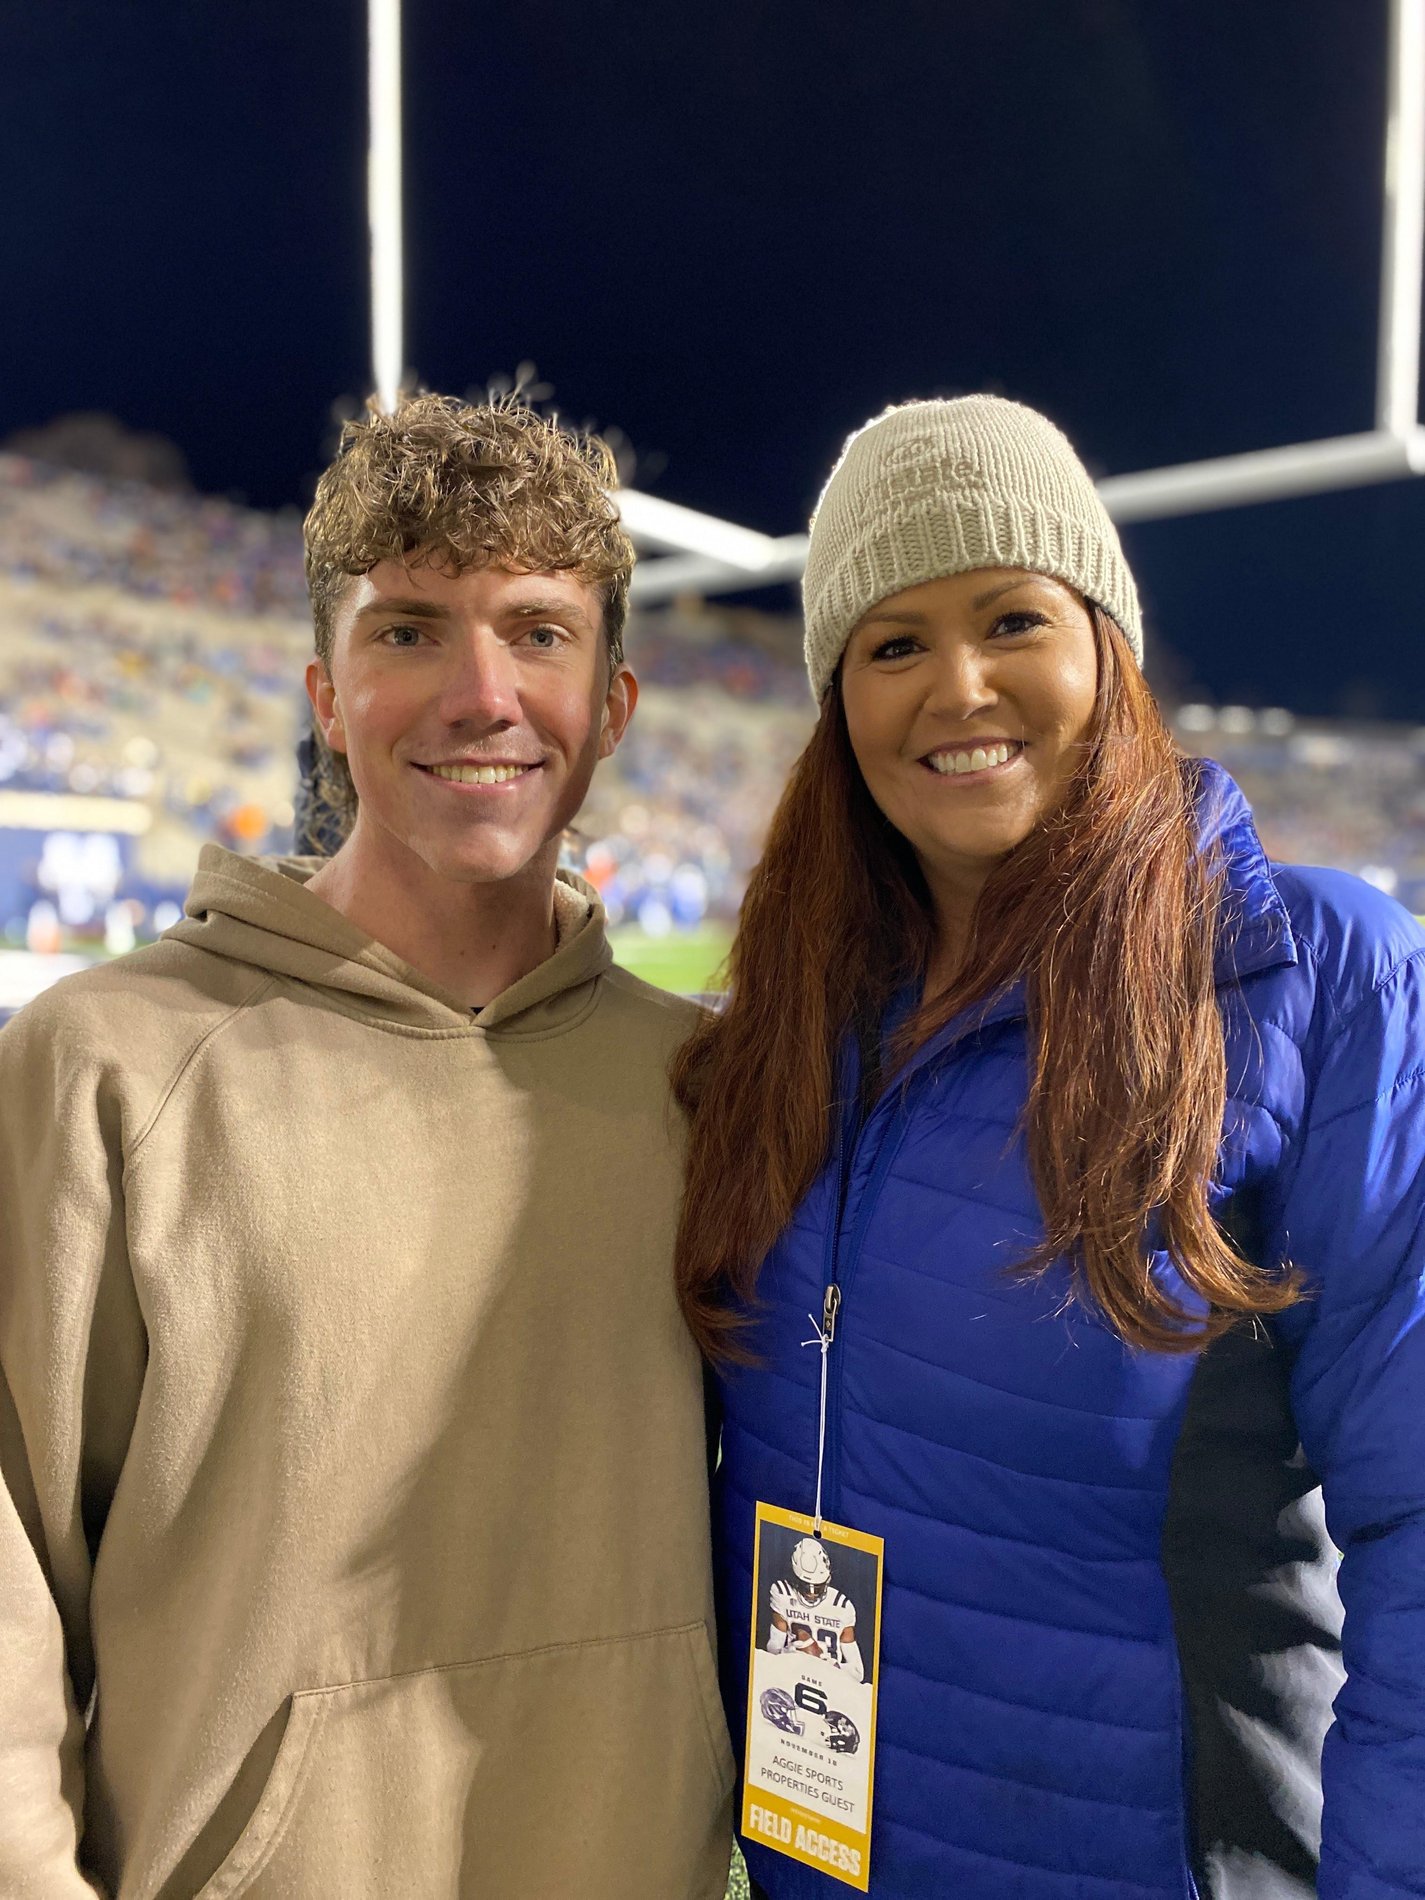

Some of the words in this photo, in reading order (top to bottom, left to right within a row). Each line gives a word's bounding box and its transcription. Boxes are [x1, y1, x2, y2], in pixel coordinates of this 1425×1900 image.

[786, 1609, 810, 1622] UTAH
[814, 1615, 841, 1629] STATE
[801, 1675, 822, 1687] GAME
[795, 1682, 828, 1715] 6
[781, 1738, 824, 1760] NOVEMBER
[772, 1755, 803, 1775] AGGIE
[806, 1768, 844, 1791] SPORTS
[761, 1767, 819, 1799] PROPERTIES
[822, 1792, 855, 1813] GUEST
[750, 1803, 792, 1844] FIELD
[795, 1824, 862, 1877] ACCESS
